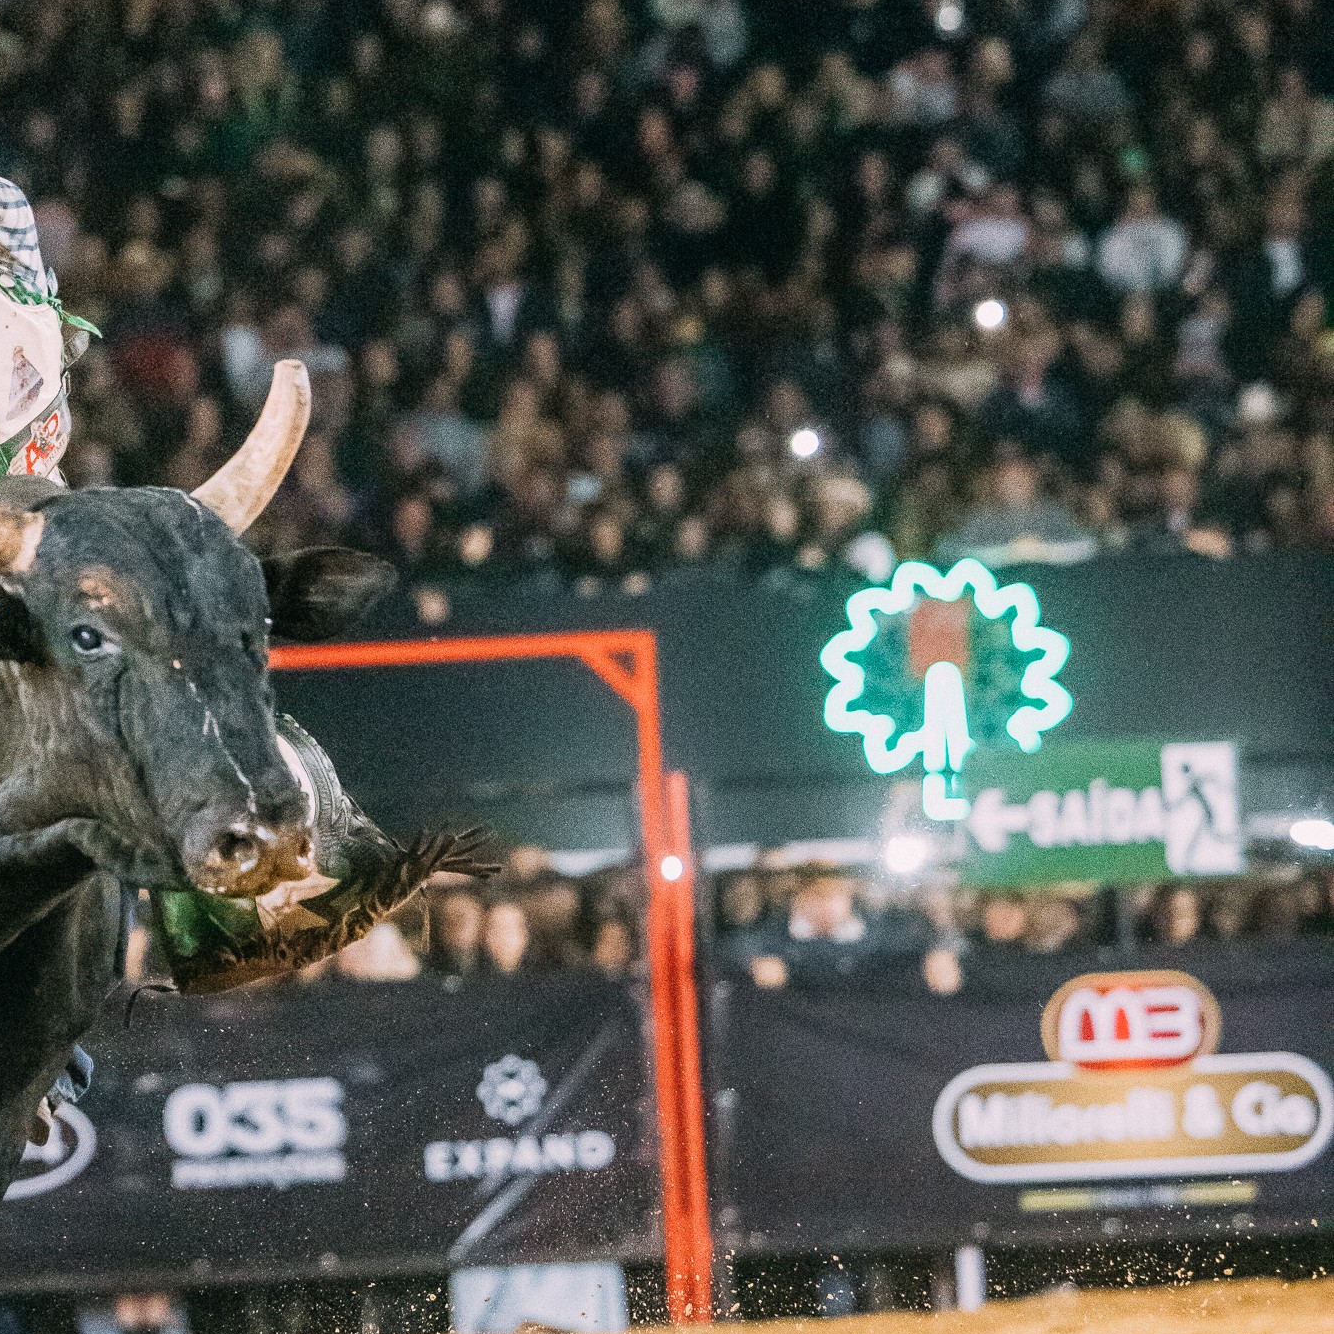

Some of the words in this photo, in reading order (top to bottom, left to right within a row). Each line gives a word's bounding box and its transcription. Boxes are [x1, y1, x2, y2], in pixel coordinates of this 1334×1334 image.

[1028, 776, 1164, 849] SAÍDA
[1060, 987, 1202, 1060] MB
[1182, 1084, 1225, 1140] &
[1232, 1081, 1318, 1136] Co
[423, 1130, 616, 1183] EXPAND
